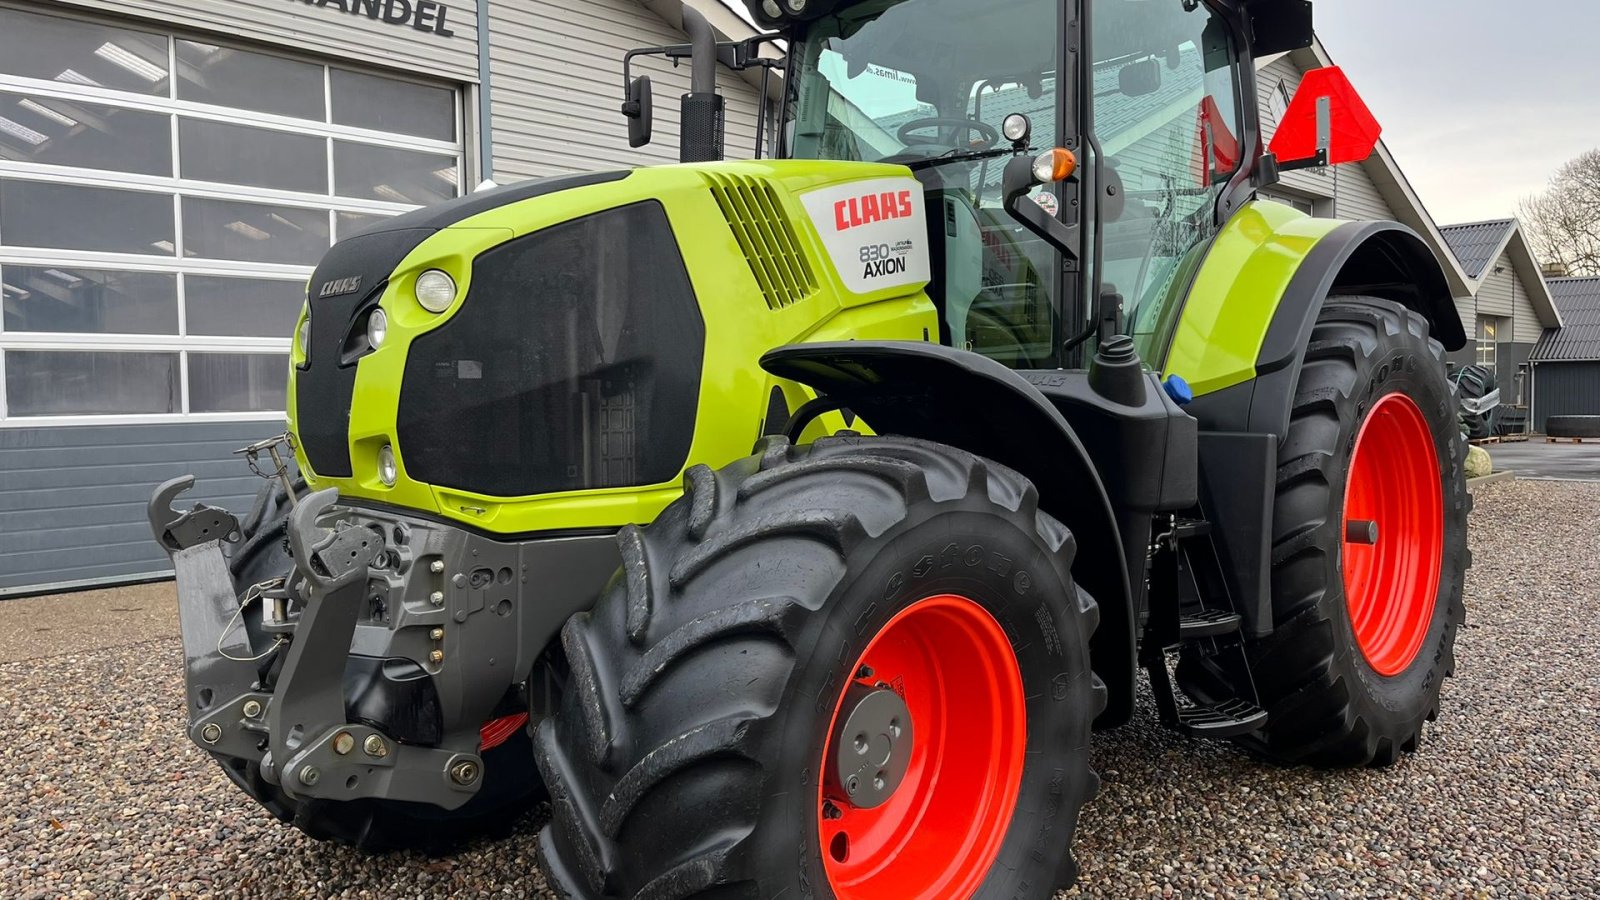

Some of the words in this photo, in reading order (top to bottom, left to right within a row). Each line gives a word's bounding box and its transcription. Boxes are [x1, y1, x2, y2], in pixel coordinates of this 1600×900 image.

[834, 190, 912, 231] CLAAS
[859, 243, 889, 263] 830
[863, 257, 906, 279] AXION
[319, 275, 362, 298] CLAAS
